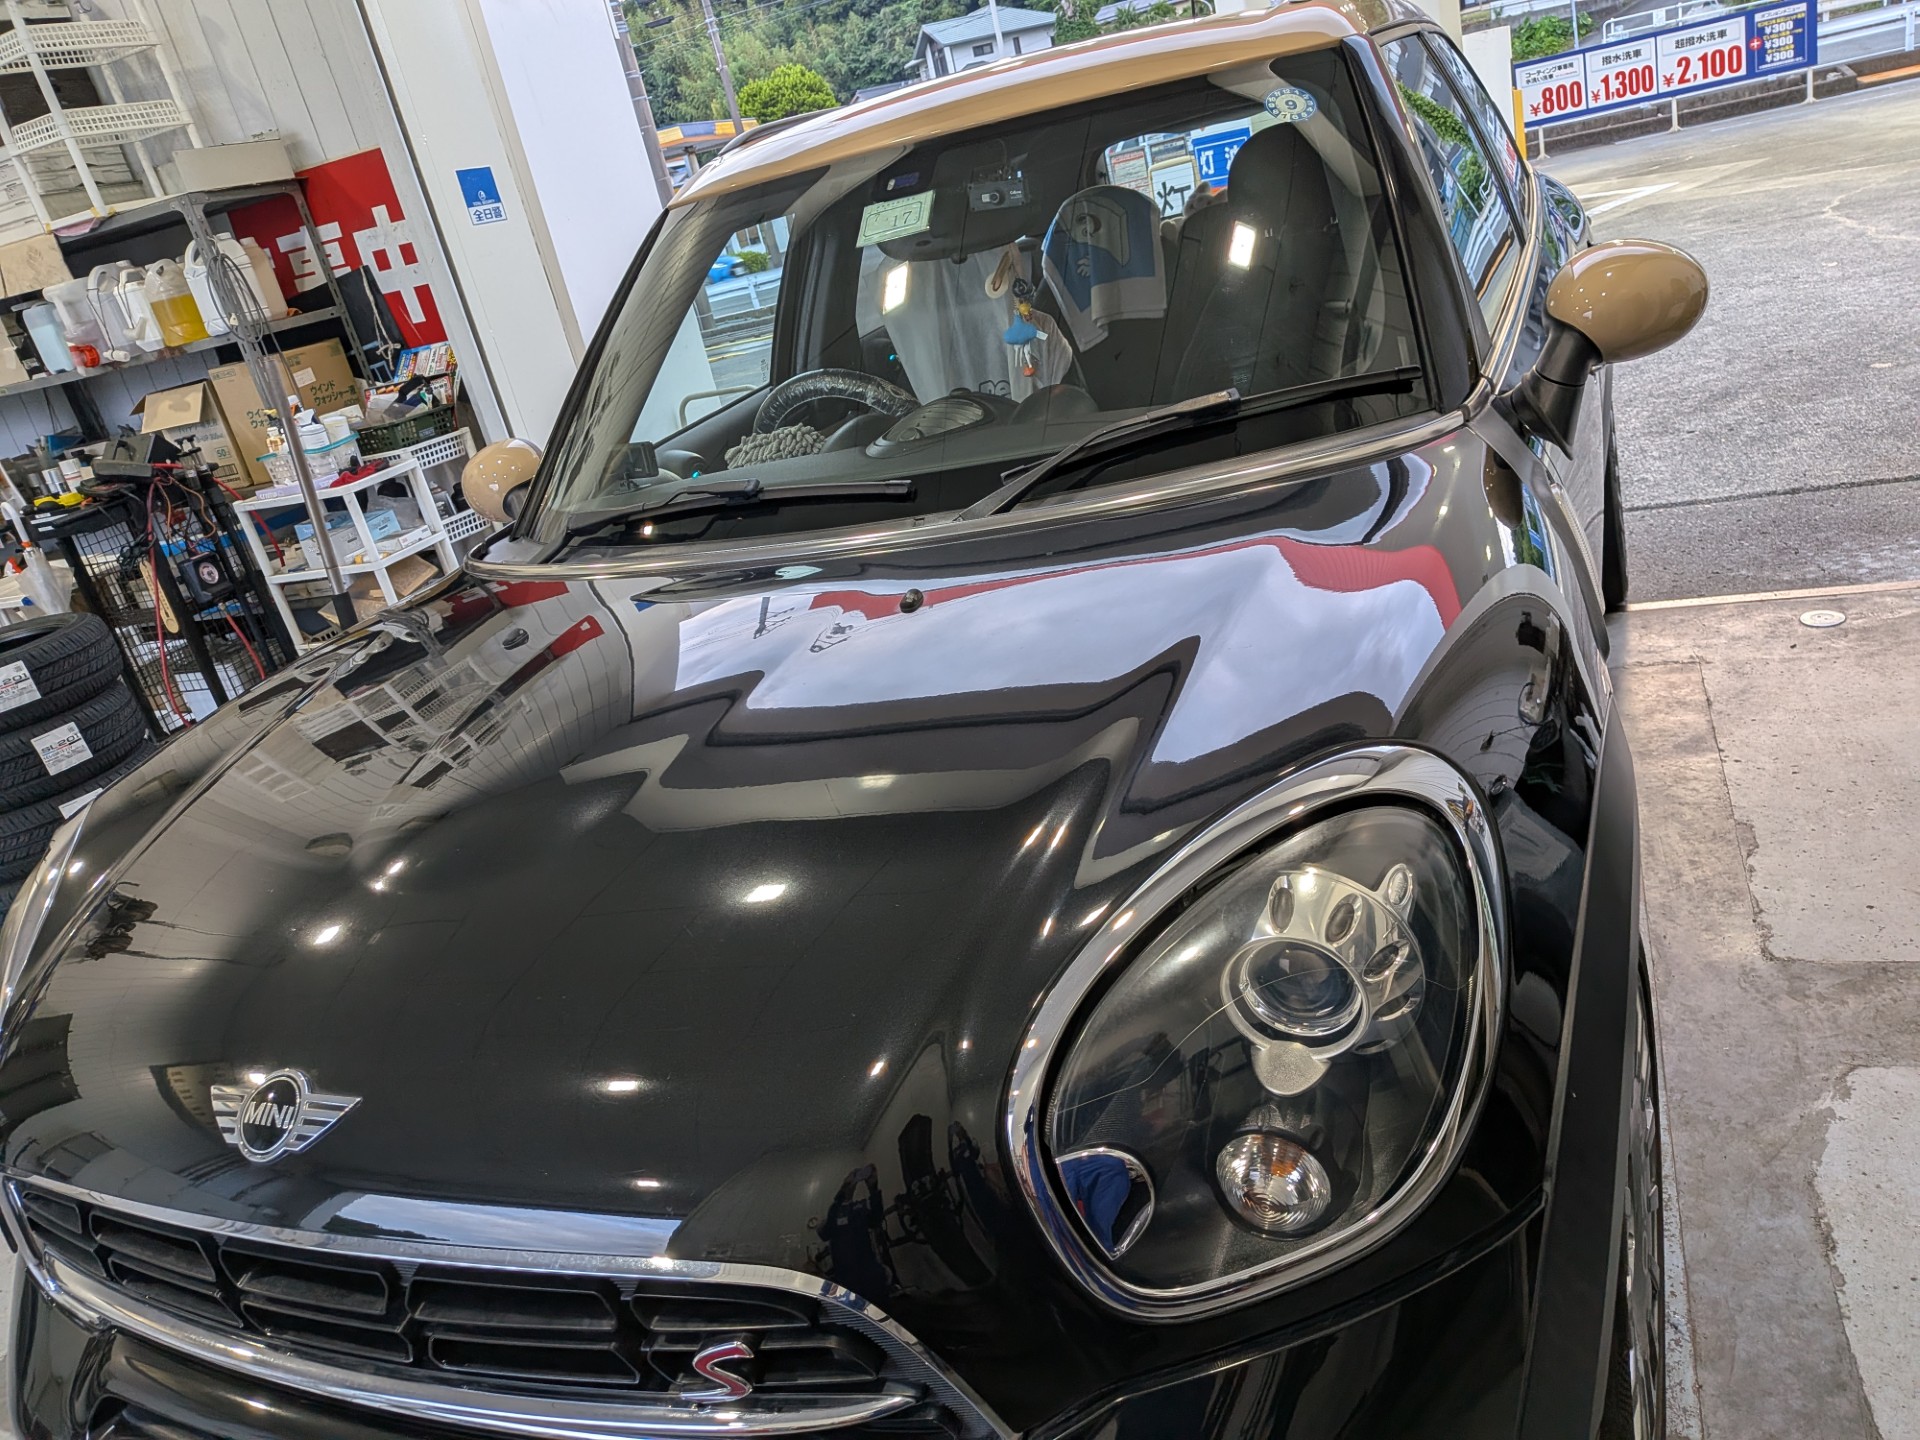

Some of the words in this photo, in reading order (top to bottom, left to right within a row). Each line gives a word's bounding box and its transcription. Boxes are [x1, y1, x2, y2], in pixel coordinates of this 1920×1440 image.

[1674, 28, 1728, 49] 超撥水洗車
[1601, 48, 1642, 66] 撥水洗車
[1662, 45, 1742, 87] ¥2,100
[1591, 65, 1654, 103] ¥1,300
[1284, 100, 1297, 110] 9
[1529, 80, 1583, 117] ¥800
[1157, 181, 1192, 217] 灯
[265, 204, 427, 324] 車中
[310, 380, 336, 395] ウインド
[216, 449, 227, 458] 50
[41, 733, 81, 754] SL201
[243, 1101, 296, 1129] MINI
[680, 1341, 755, 1404] S
